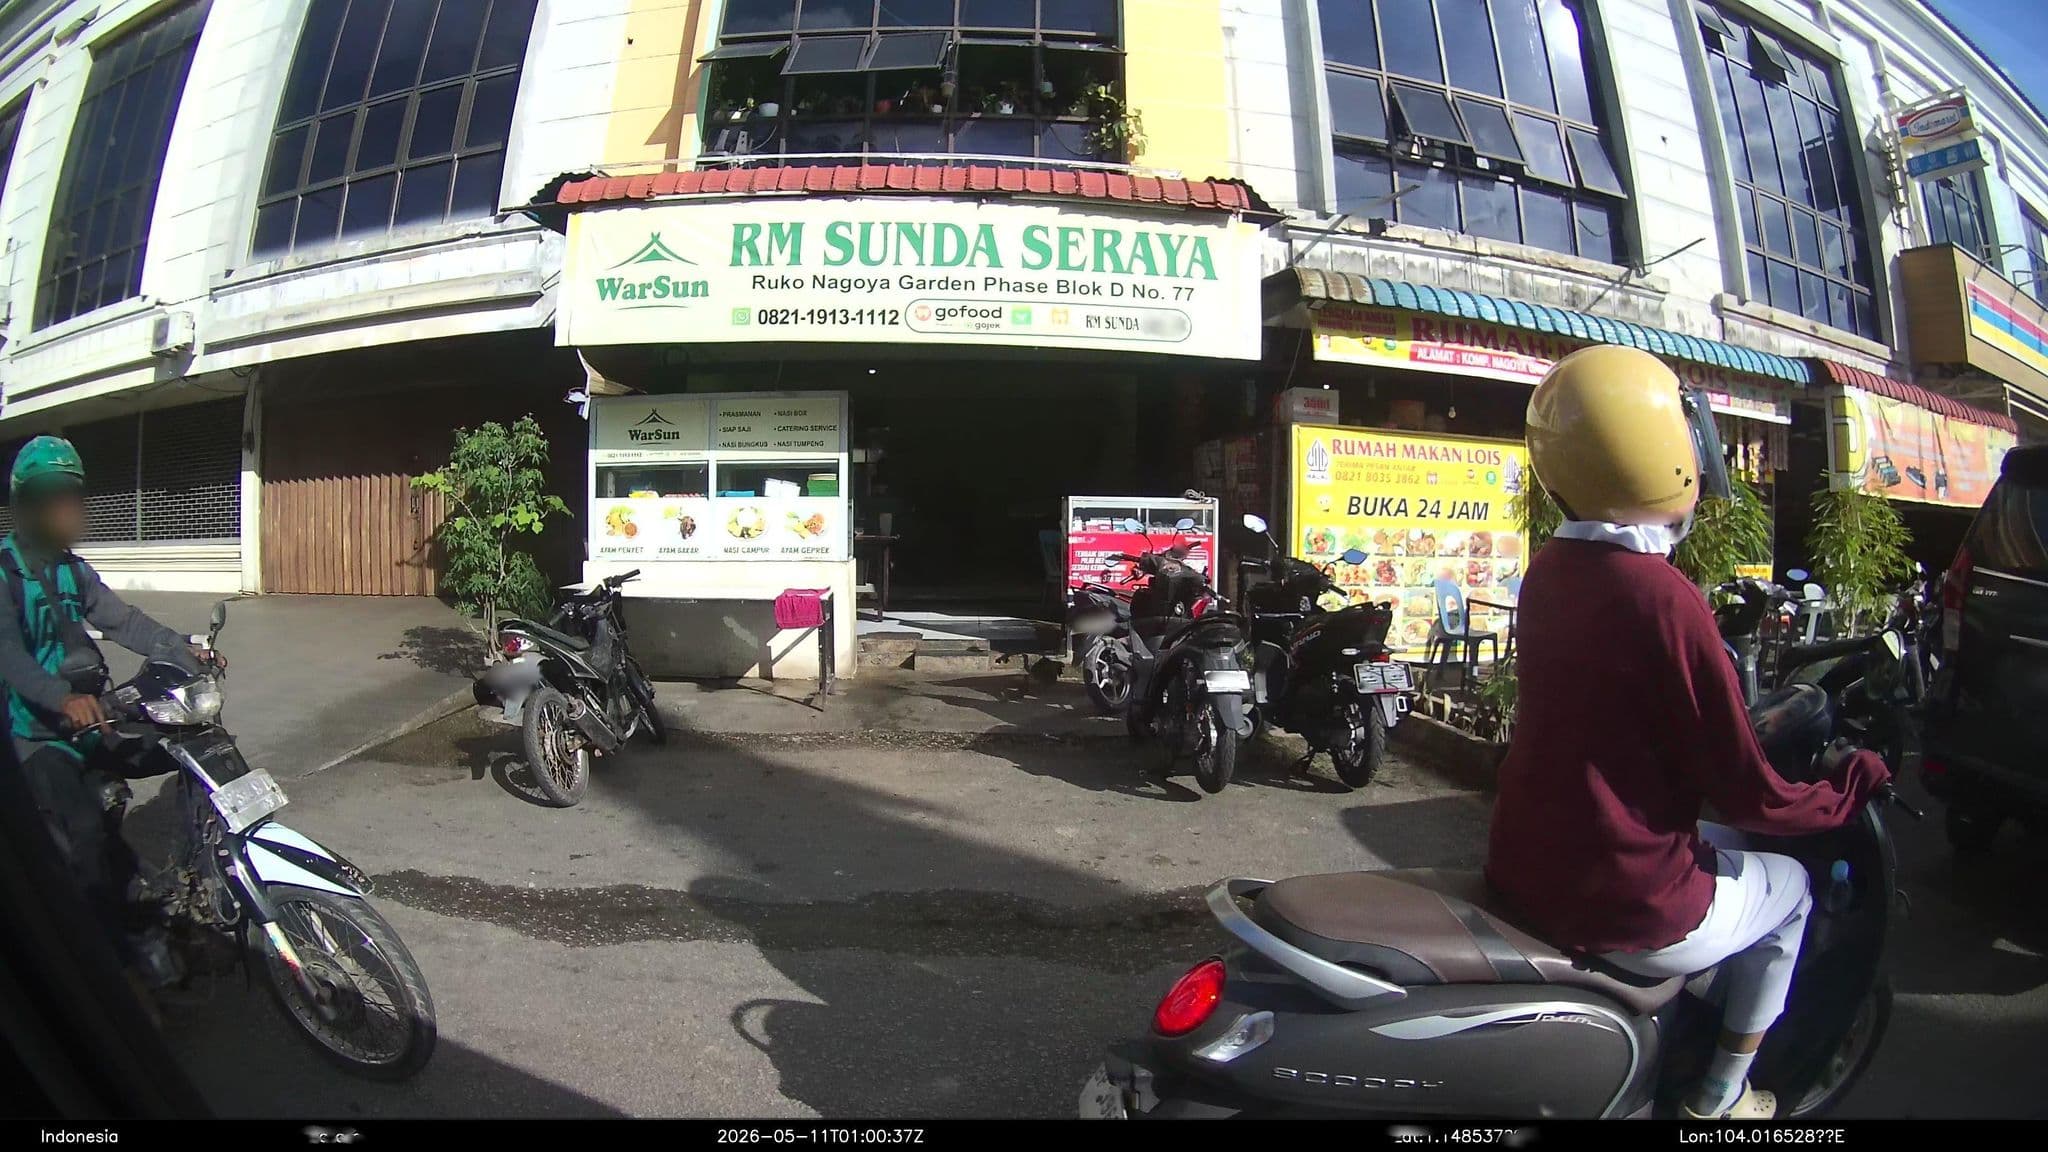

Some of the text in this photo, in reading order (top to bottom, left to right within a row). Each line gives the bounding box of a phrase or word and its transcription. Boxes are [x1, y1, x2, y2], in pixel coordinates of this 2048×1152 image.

[729, 221, 1218, 280] RM SUNDA SERAYA
[596, 275, 710, 301] WarSun
[752, 274, 1195, 301] Ruko Nagoya Garden Phase Blok D No. 77
[758, 308, 899, 325] 0821-1913-1112
[935, 305, 1002, 321] gofood
[975, 321, 1000, 330] gojek
[1086, 315, 1101, 329] RM
[1105, 316, 1140, 331] SUNDA
[1411, 317, 1549, 361] RUMAH
[722, 410, 761, 418] PRASMANAN
[628, 429, 680, 441] WarSun
[810, 424, 838, 432] SERVICE
[1332, 439, 1501, 465] RUMAH MAKAN LOIS
[1336, 470, 1361, 481] 0821
[1347, 495, 1489, 520] BUKA 24 JAM
